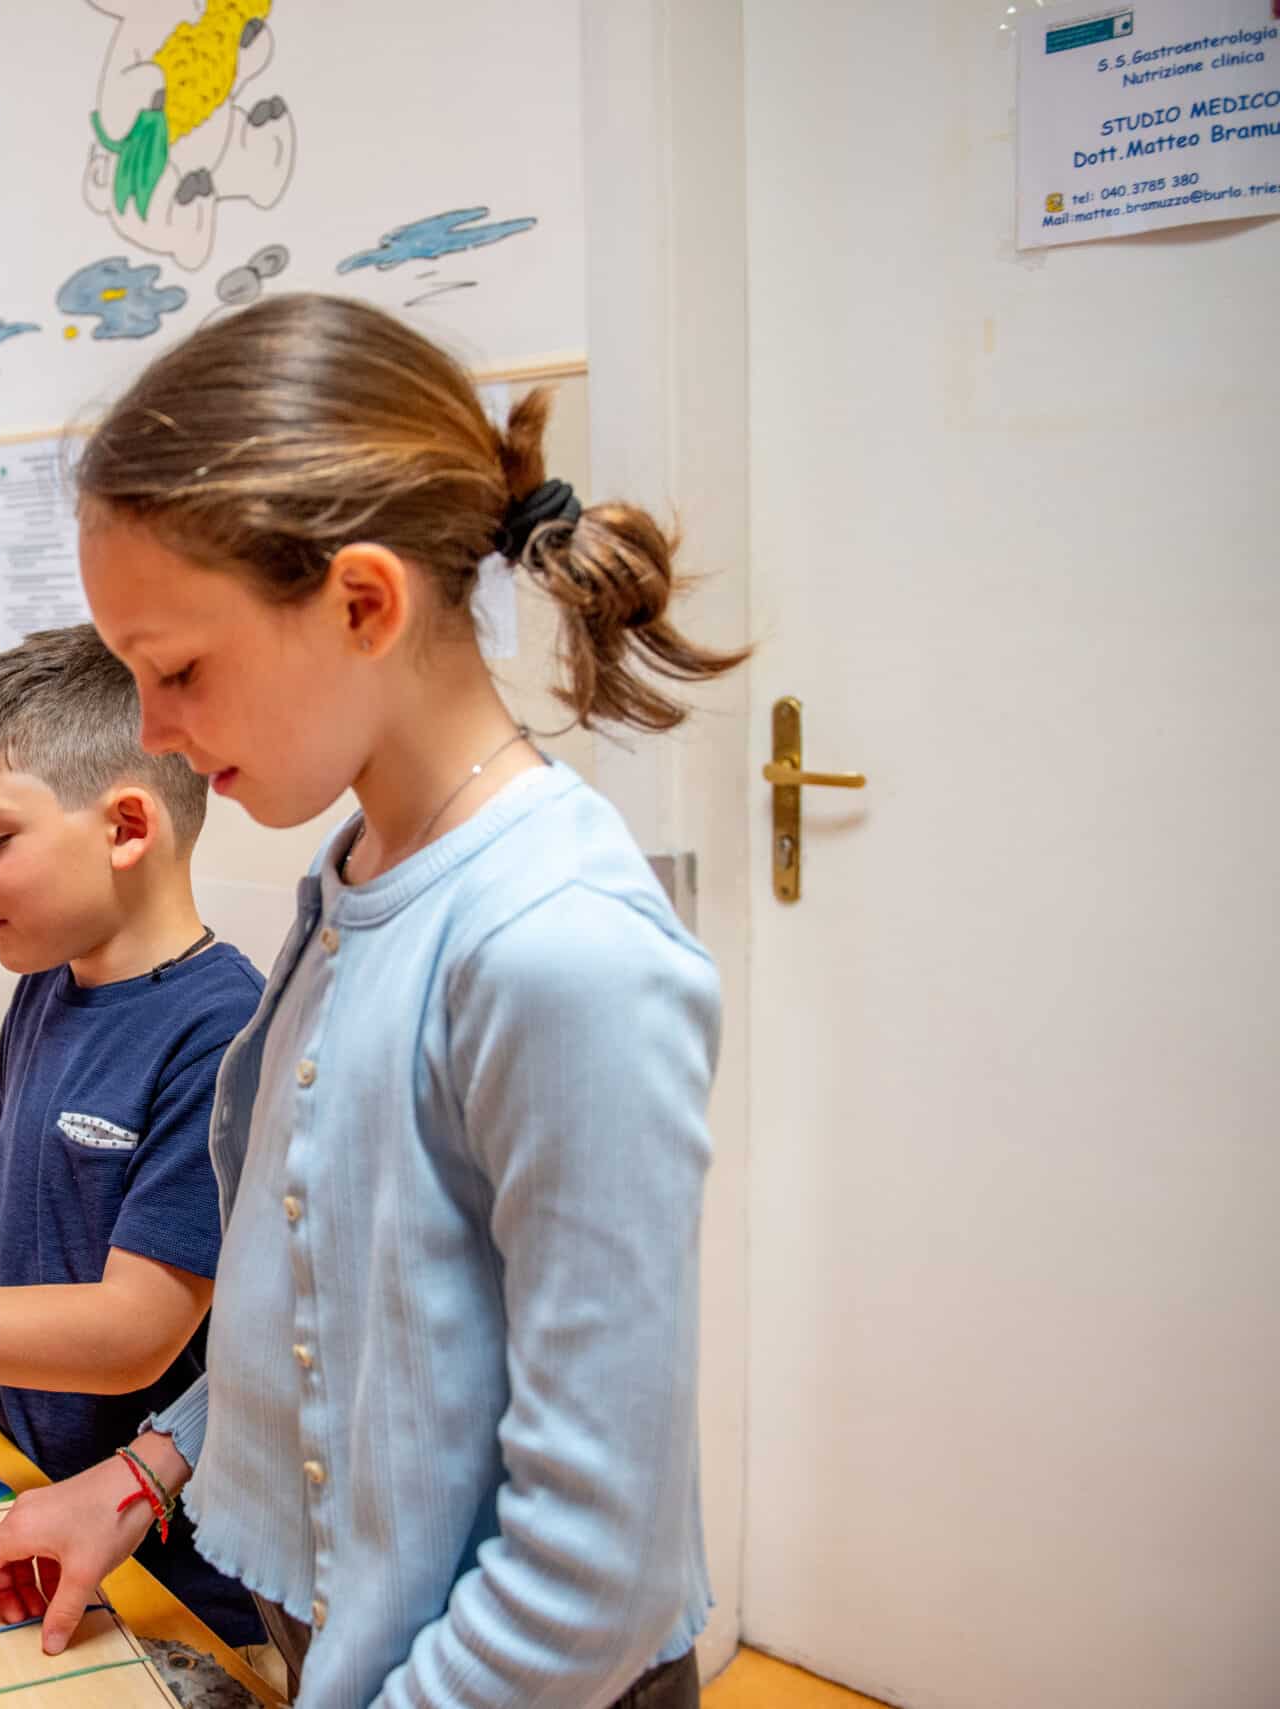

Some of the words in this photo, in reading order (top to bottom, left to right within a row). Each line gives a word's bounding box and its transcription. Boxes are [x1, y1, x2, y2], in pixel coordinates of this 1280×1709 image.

[1096, 26, 1278, 73] S.S.Gastroenterologia
[1122, 61, 1204, 87] Nutrizione
[1210, 51, 1265, 69] clinica
[1100, 106, 1181, 136] STUDIO
[1189, 91, 1280, 119] MEDICO
[1072, 132, 1200, 168] Dott.Matteo
[1210, 121, 1280, 144] Bramu
[1072, 192, 1094, 206] tel:
[1172, 172, 1200, 189] 380
